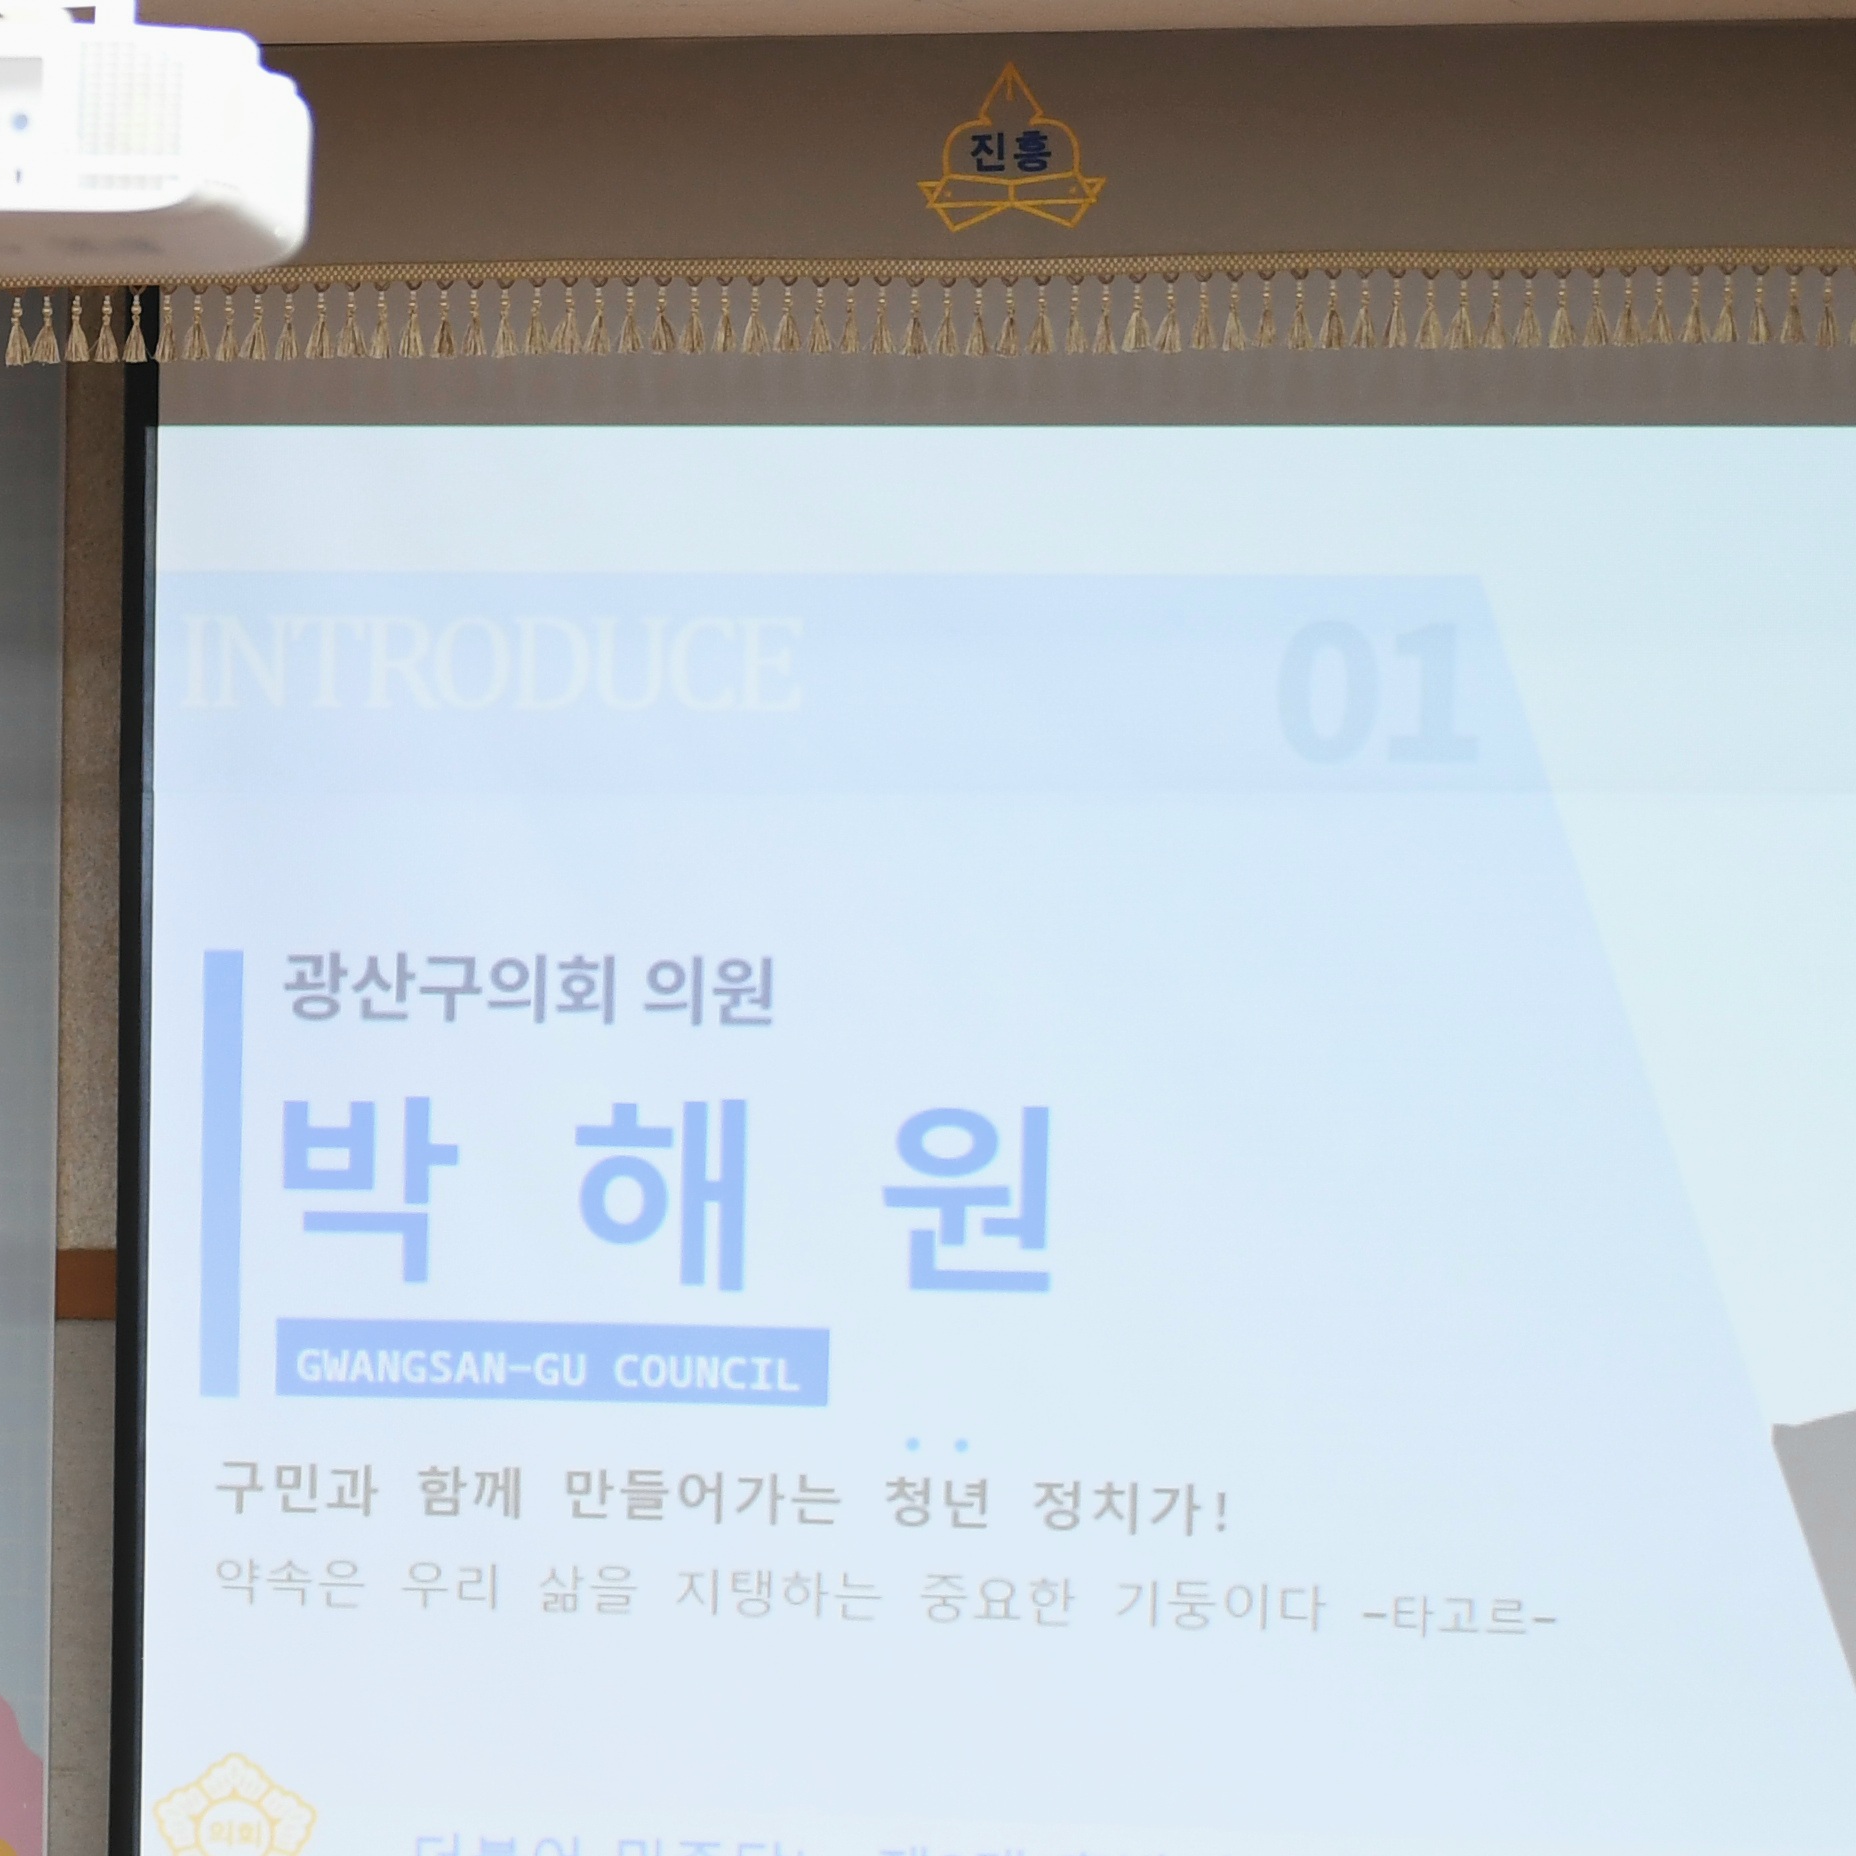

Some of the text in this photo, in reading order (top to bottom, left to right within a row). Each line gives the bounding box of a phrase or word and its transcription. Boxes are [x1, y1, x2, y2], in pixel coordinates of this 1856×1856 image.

[971, 131, 1051, 172] 진흥
[180, 614, 804, 712] INTRODUCE
[1277, 618, 1479, 765] 01
[284, 951, 773, 1027] 광산구의회 의원
[296, 1349, 800, 1392] GWANGSAN-GU COUNCIL
[215, 1461, 1226, 1537] 구민과 함께 만들어가는 청년 정치가!
[215, 1558, 1556, 1638] 약속은 우리 삶을 지탱하는 중요한 기둥이다 -타고르-
